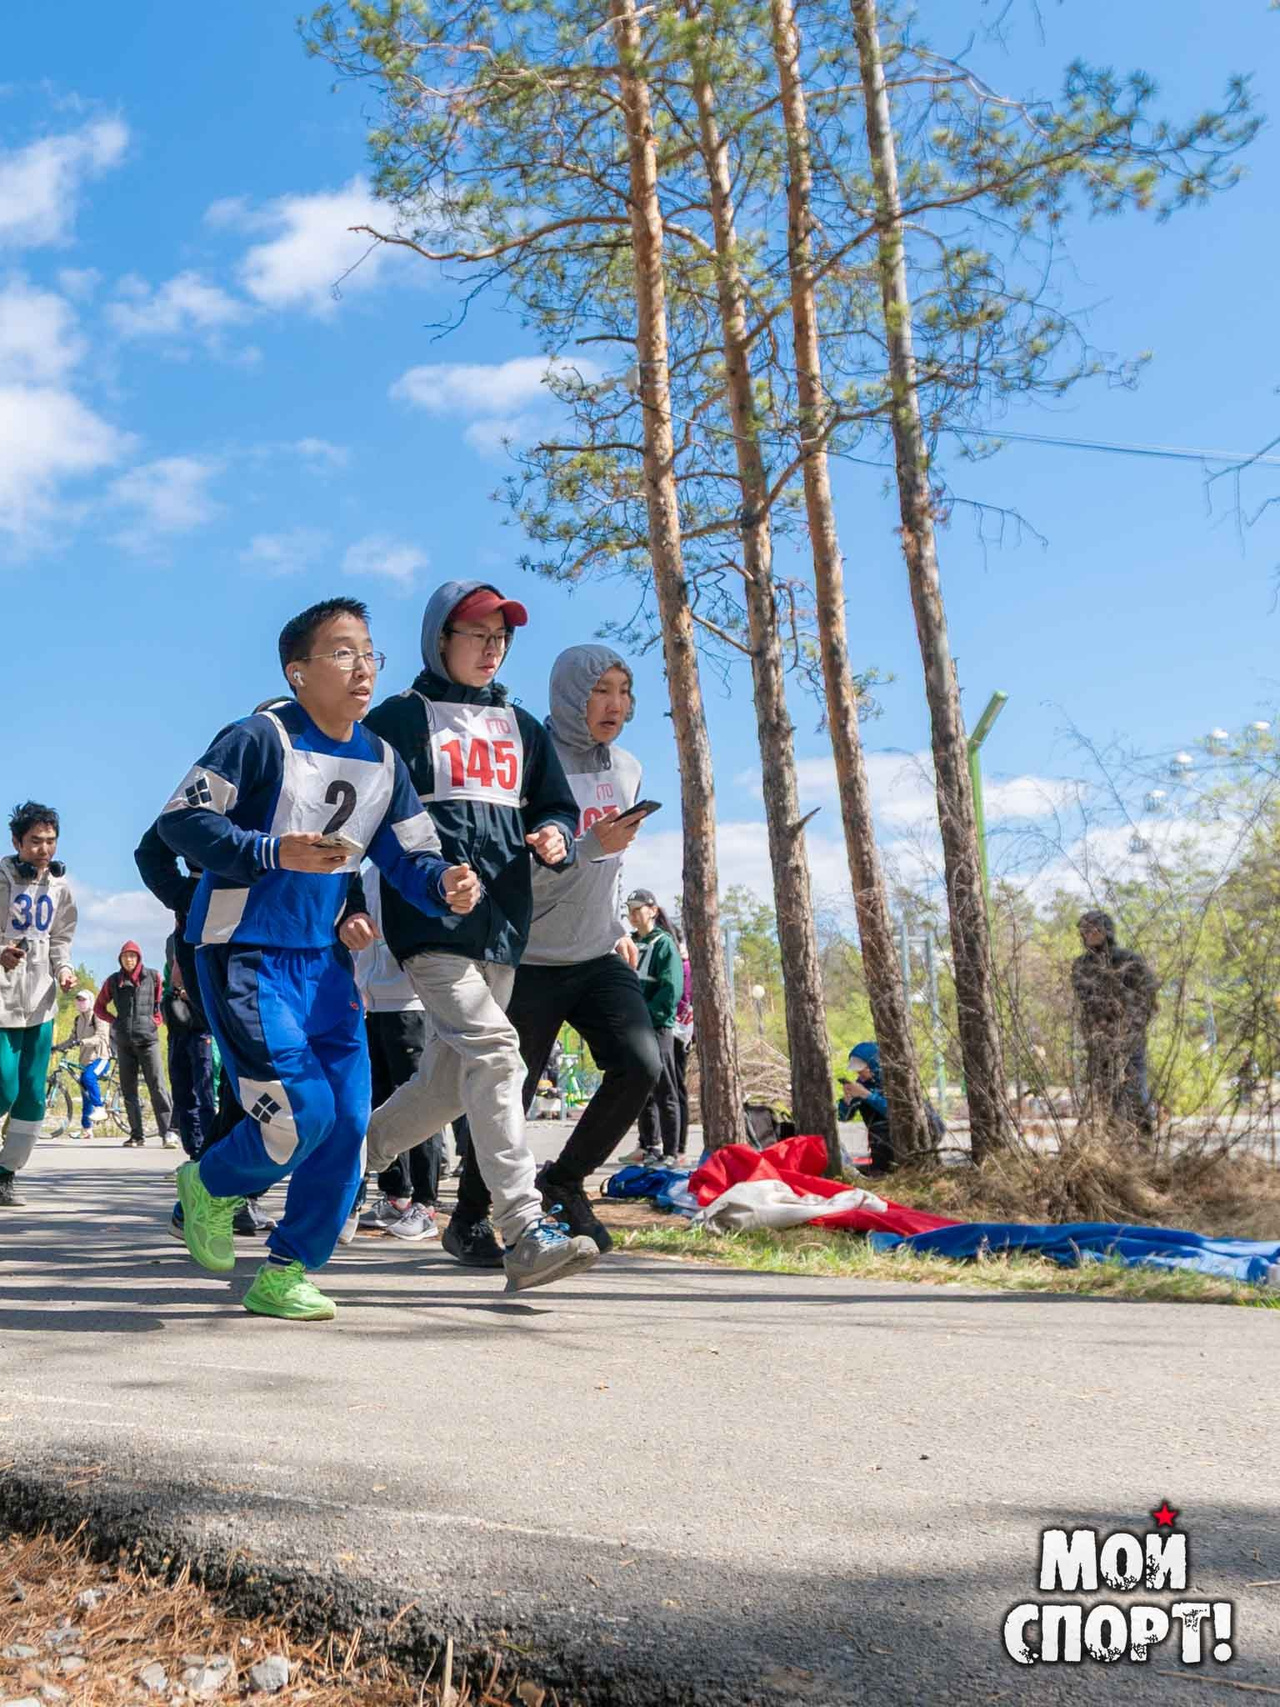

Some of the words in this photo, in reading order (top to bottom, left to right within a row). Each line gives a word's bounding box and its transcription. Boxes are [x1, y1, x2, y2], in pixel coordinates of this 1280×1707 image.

[485, 717, 511, 734] ГТО
[440, 738, 517, 790] 145
[322, 779, 357, 836] 2
[11, 893, 53, 931] 30
